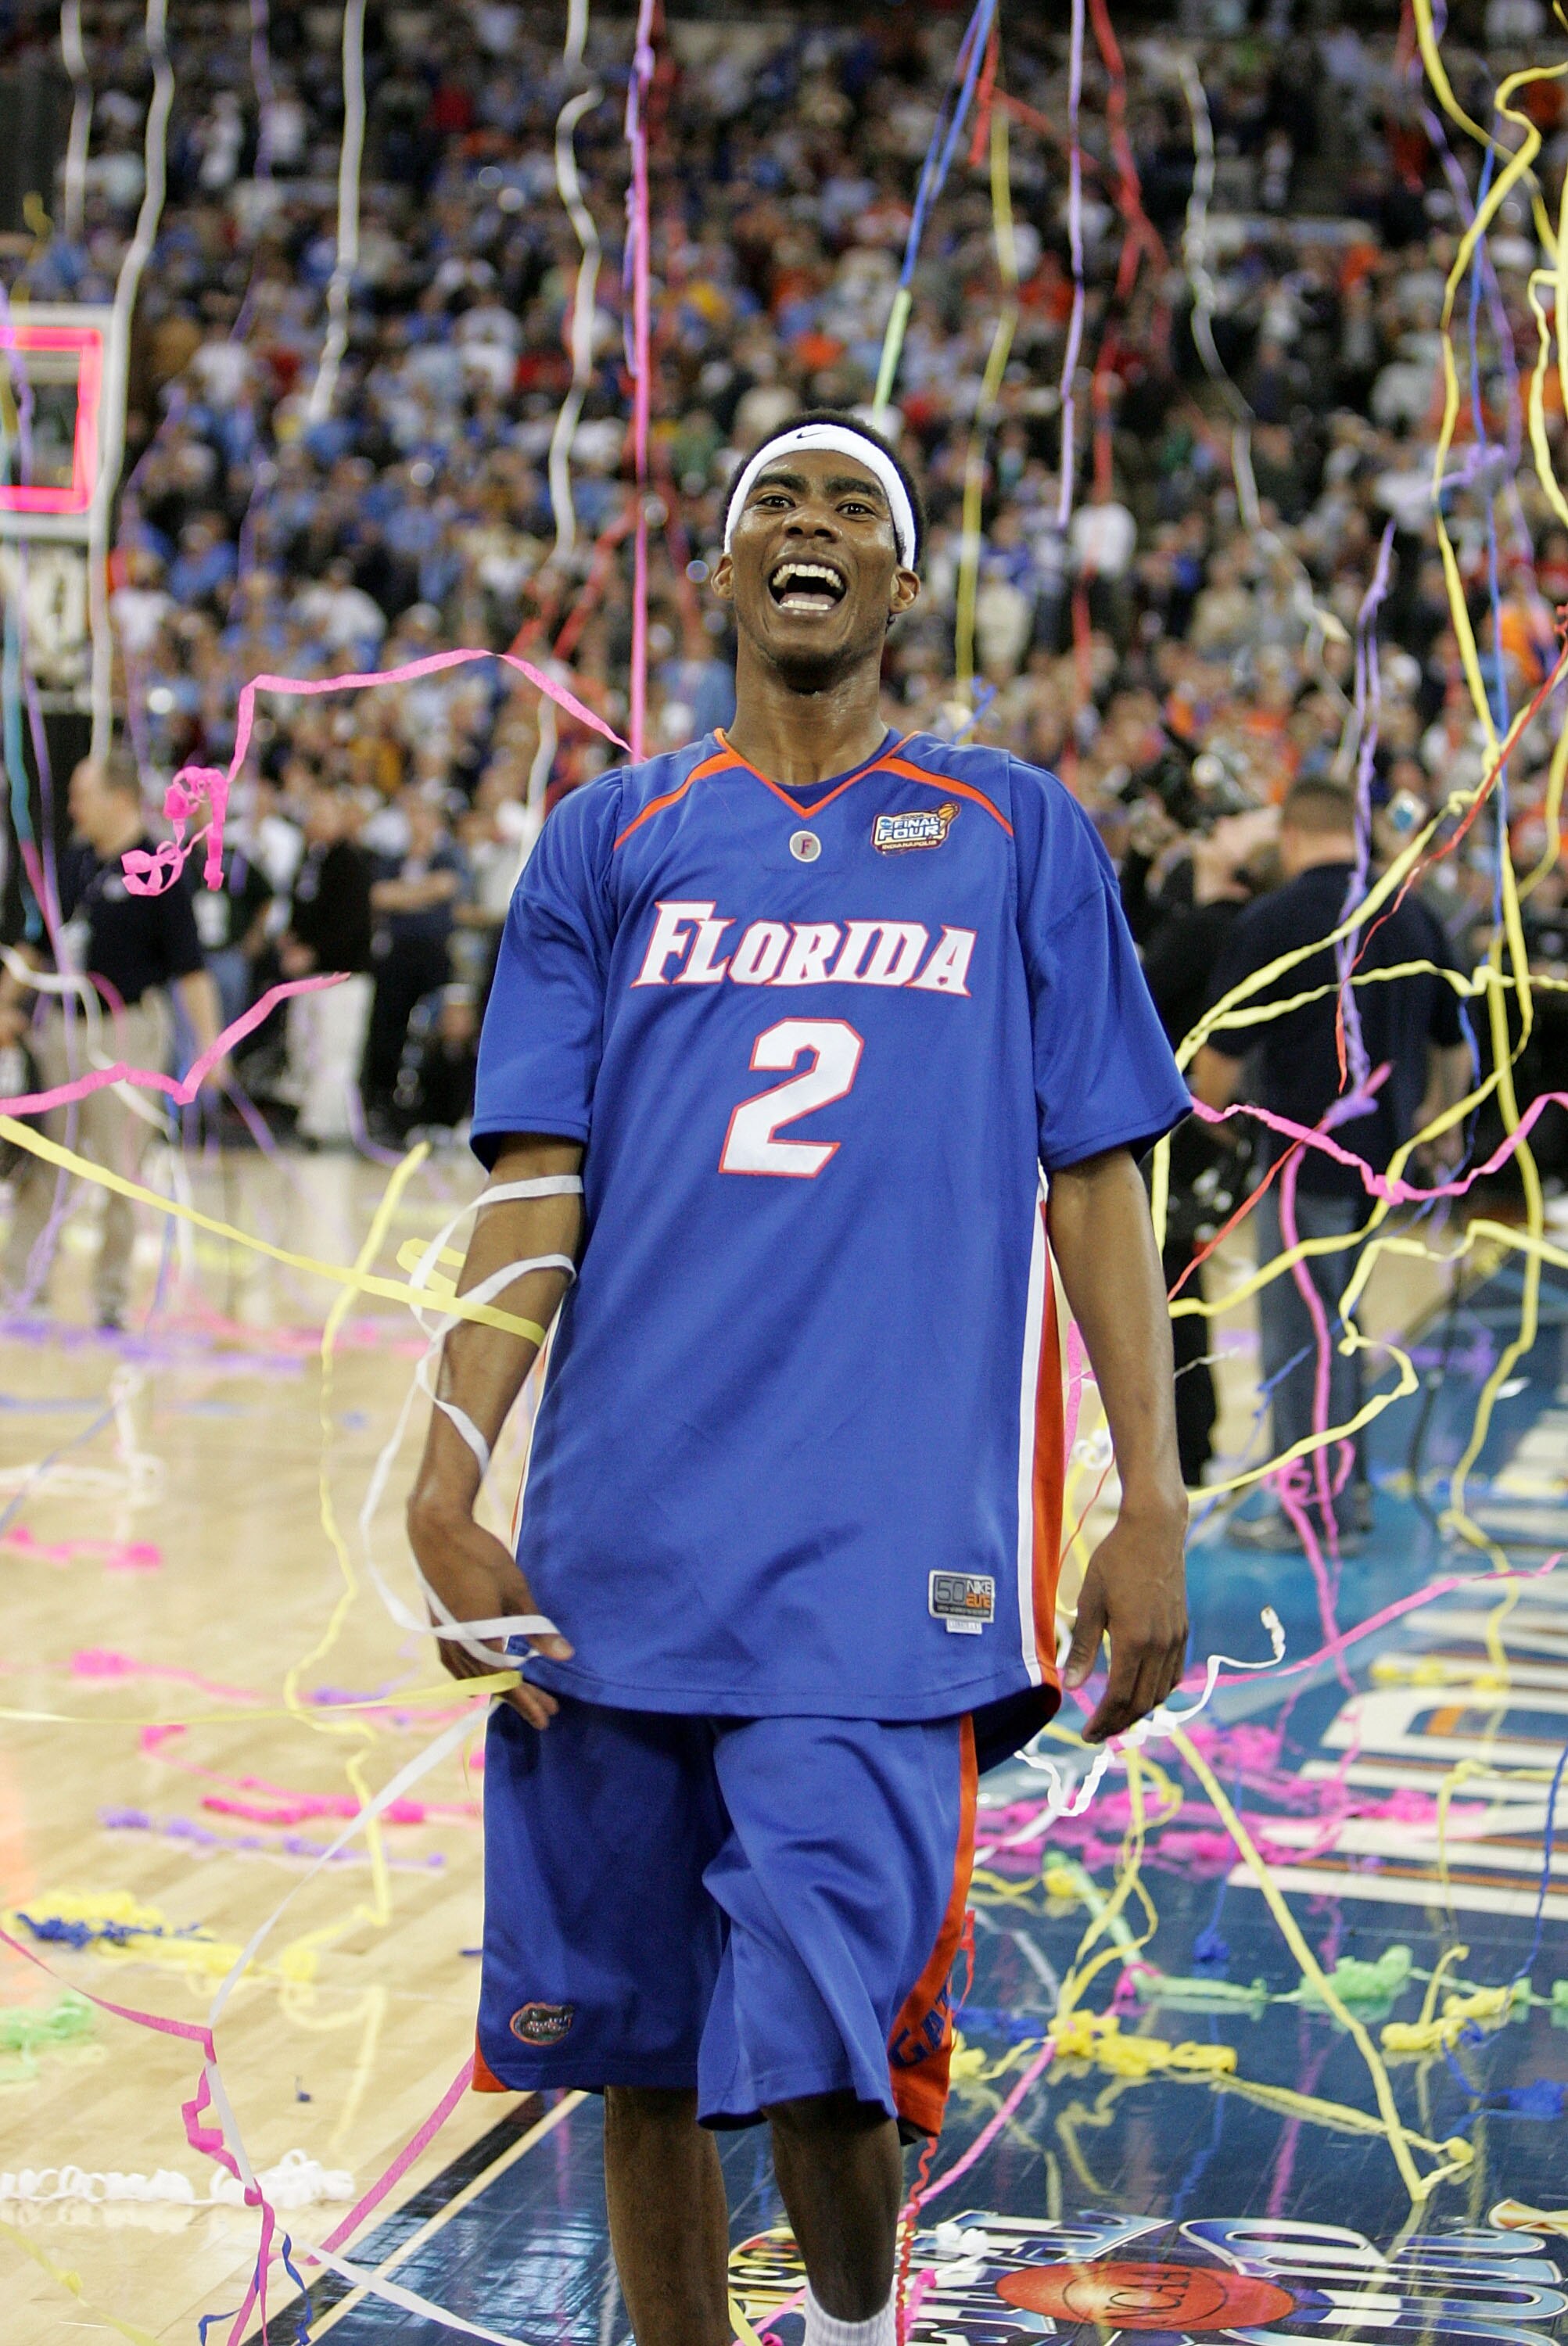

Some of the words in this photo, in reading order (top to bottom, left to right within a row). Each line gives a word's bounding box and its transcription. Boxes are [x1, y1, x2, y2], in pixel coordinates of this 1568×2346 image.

[894, 817, 939, 829] FINAL
[879, 825, 939, 841] FOUR
[800, 838, 813, 856] F
[881, 840, 937, 849] INDIANAPOLIS
[630, 901, 978, 998] FLORIDA
[718, 1017, 864, 1178] 2
[938, 1580, 965, 1602] 50
[967, 1580, 991, 1595] NIKE
[1100, 2270, 1191, 2325] NCAA
